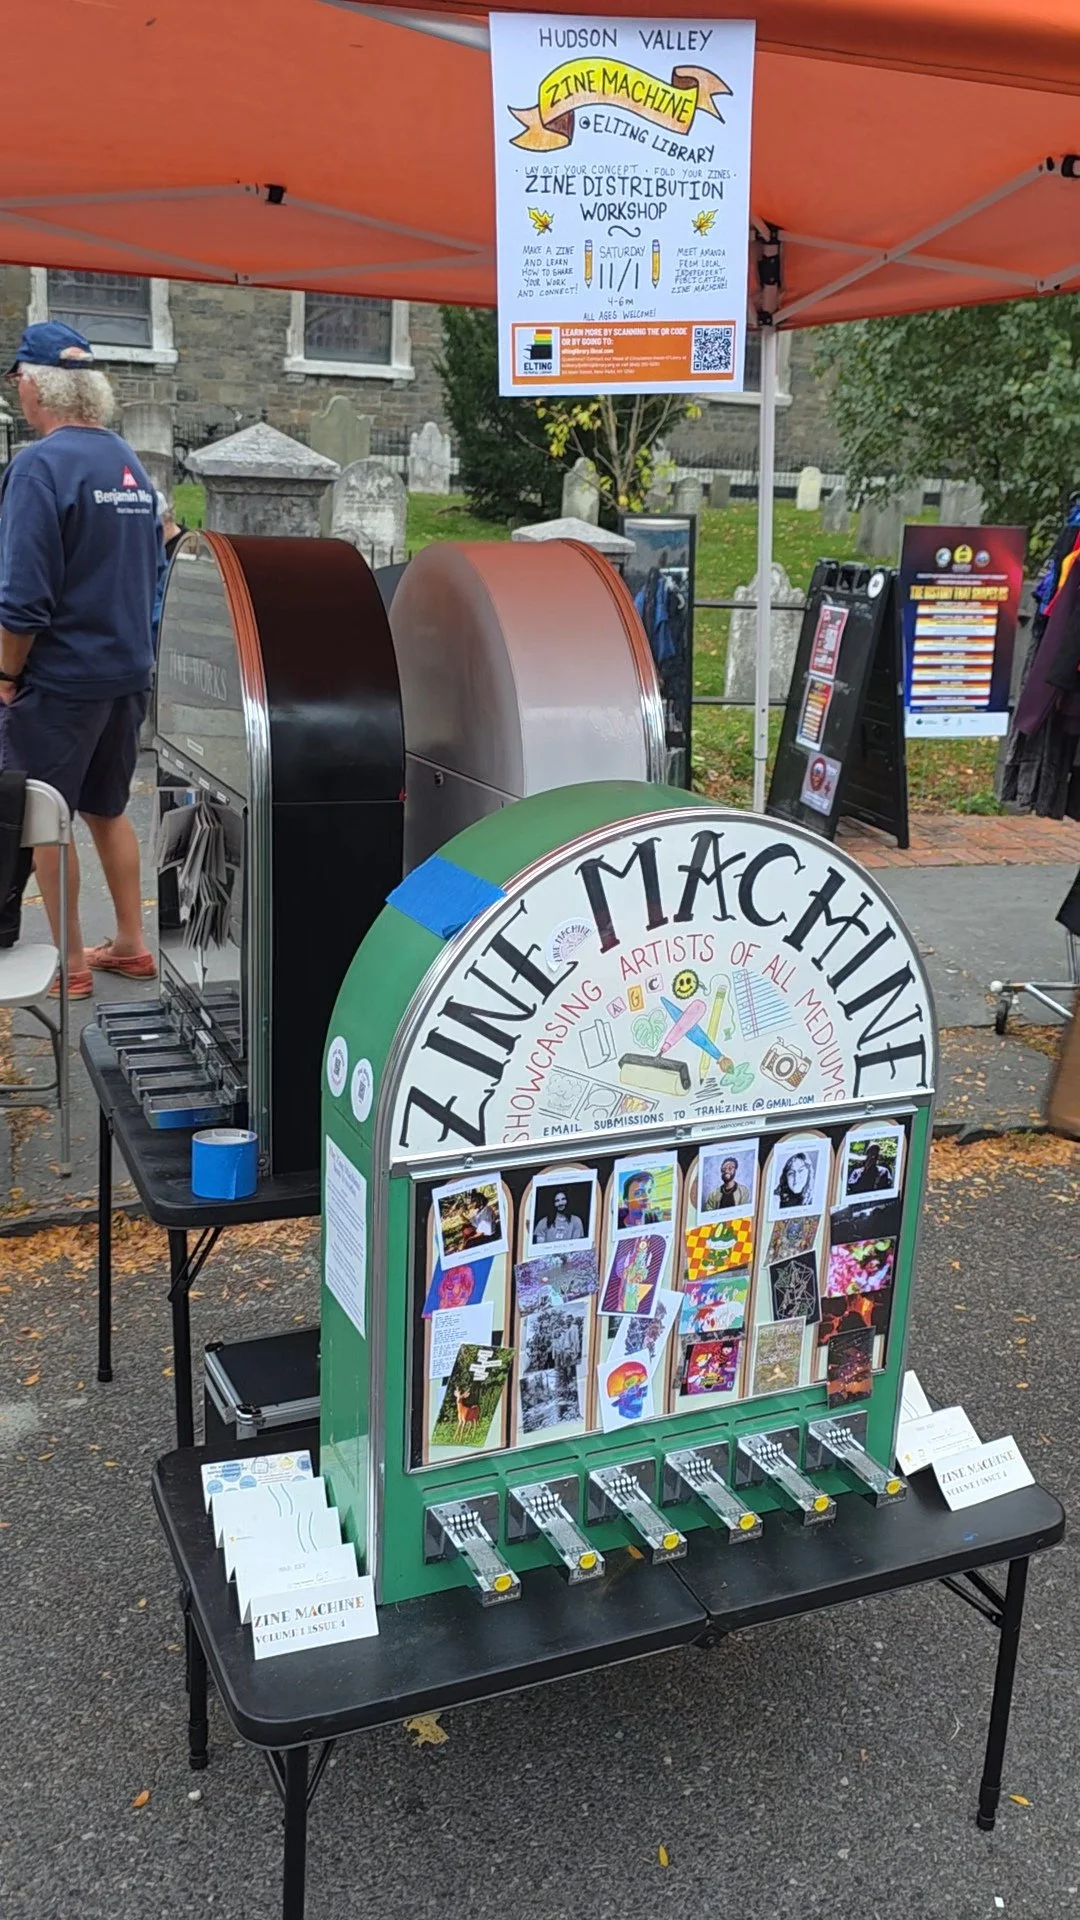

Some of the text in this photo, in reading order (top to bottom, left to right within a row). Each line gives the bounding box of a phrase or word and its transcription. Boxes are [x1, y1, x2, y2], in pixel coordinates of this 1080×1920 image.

[539, 27, 713, 51] HUDSON VALLEY
[545, 67, 693, 124] ZINE MACHINE
[593, 114, 652, 144] ELTING
[652, 135, 715, 164] LIBRARY
[525, 164, 731, 179] LAY OUT YOUR CONCEPT FOLD YOUR ZINES
[525, 174, 724, 201] ZINE DISTRIBUTION
[579, 201, 668, 221] WORKSHOP
[522, 245, 575, 256] MAKE A ZINE
[599, 245, 646, 259] SATURDAY
[676, 247, 726, 257] MEET AMANDA
[524, 258, 569, 267] AND LEARN
[679, 259, 721, 268] FROM LOCAL
[521, 267, 540, 276] HOW
[600, 258, 639, 292] 11/1
[675, 267, 726, 278] INDEPENDENT
[524, 277, 567, 287] YOUR WORK
[671, 279, 728, 294] ZINE MACHINE!
[517, 282, 579, 299] AND CONNECT!
[583, 307, 657, 321] ALL AGES WELCOME!
[561, 327, 688, 337] LEARN MORE BY SCANNING THE QR CODE
[561, 338, 571, 346] OR
[581, 337, 602, 345] GOING
[523, 362, 552, 371] ELTING
[93, 488, 138, 506] Benjamin
[398, 829, 928, 1147] ZINE MACHINE
[503, 933, 846, 1143] SHOWCASING ARTISTS OF ALL MEDIUMS
[543, 1123, 583, 1137] EMAIL
[593, 1112, 664, 1131] SUBMISSIONS
[673, 1110, 686, 1120] TO
[940, 1449, 1016, 1485] ZINE MACHINE
[253, 1595, 365, 1629] ZINE MACHINE
[255, 1627, 299, 1644] VOLUME
[307, 1620, 338, 1635] ISSUE
[339, 1618, 346, 1628] 4
